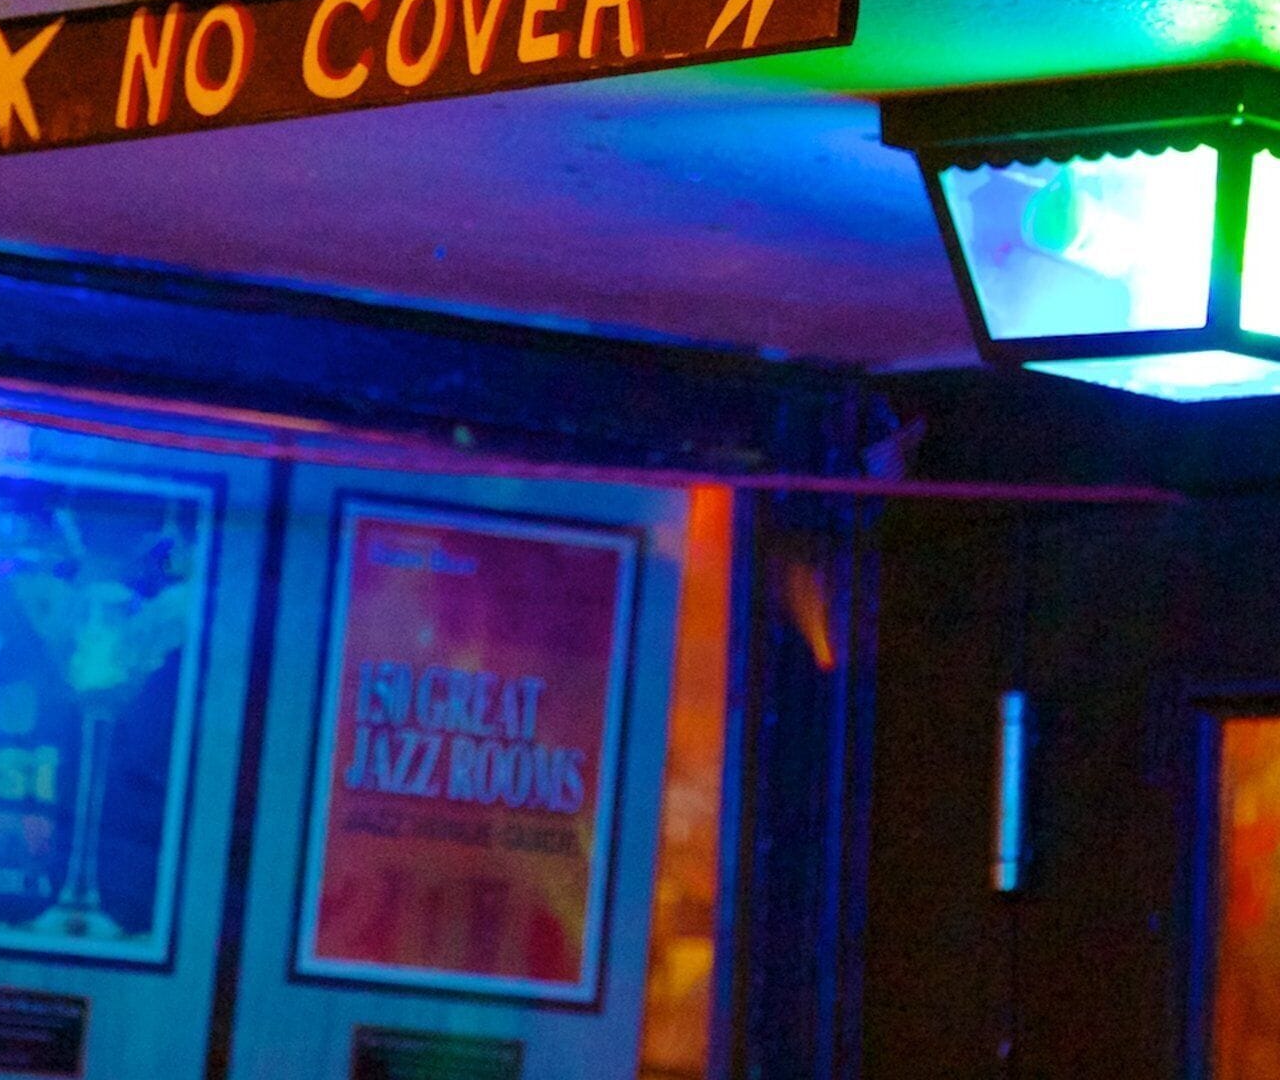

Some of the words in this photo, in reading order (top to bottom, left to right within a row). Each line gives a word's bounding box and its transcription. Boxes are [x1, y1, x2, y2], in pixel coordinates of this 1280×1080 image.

[115, 1, 254, 130] NO
[418, 665, 547, 740] GREAT
[345, 725, 442, 798] JAZZ
[448, 735, 586, 814] ROOMS
